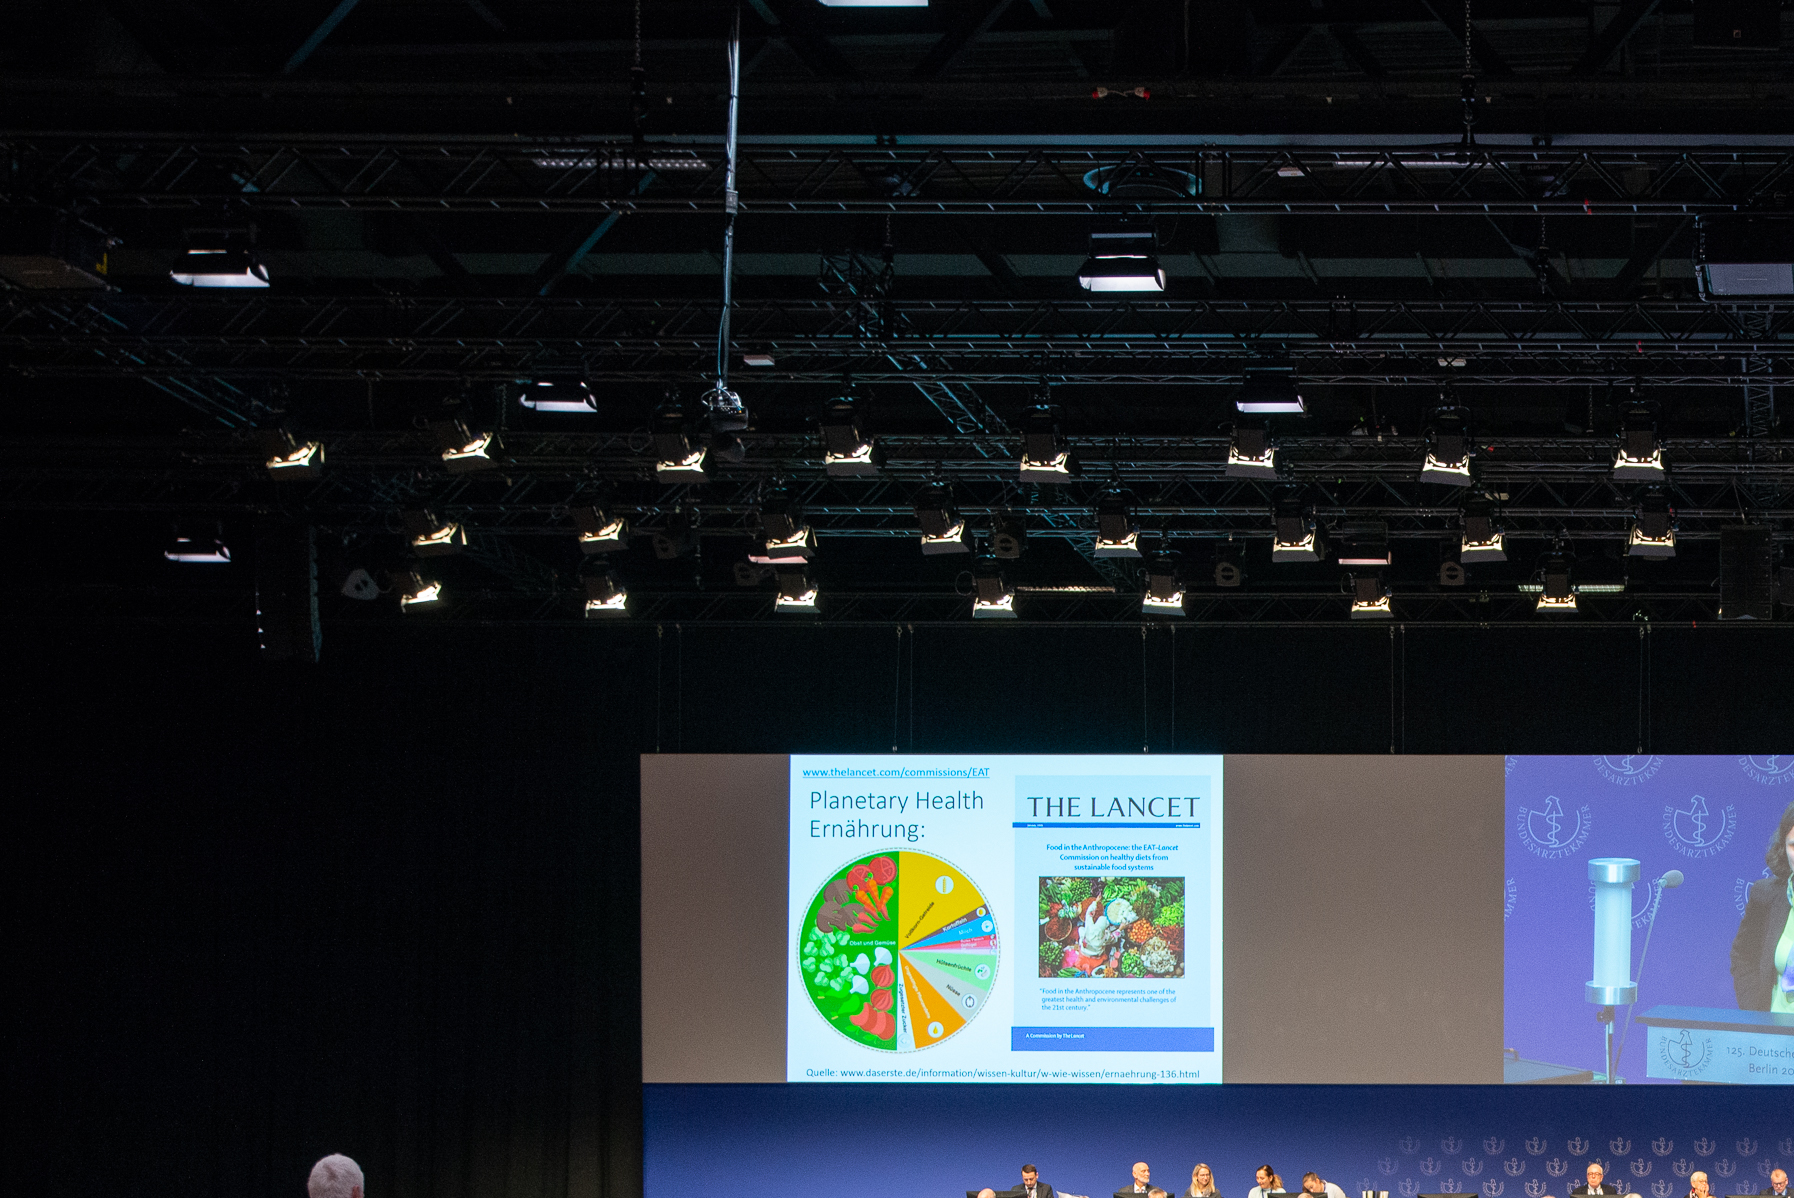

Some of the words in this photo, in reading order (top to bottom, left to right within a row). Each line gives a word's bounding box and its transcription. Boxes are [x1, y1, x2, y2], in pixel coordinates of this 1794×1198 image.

[803, 767, 990, 777] www.thelancet.com/commissions/EAT
[810, 790, 908, 813] Planetary
[916, 791, 984, 810] Health
[1026, 797, 1080, 817] THE
[1091, 797, 1200, 817] LANCET
[810, 818, 926, 842] Ernährung:
[1082, 844, 1131, 853] Anthropocene:
[1110, 854, 1134, 862] healthy
[1075, 988, 1116, 997] Anthropocene
[1116, 989, 1146, 997] represents
[1041, 997, 1065, 1005] greatest
[1139, 996, 1170, 1005] challenges
[1726, 1046, 1745, 1058] 125.
[806, 1068, 838, 1077] Quelle:
[840, 1068, 1200, 1079] www.daserste.de/information/wissen-kultur/w-wie-wissen/ernaehrung-136.html
[1748, 1063, 1778, 1075] Berlin
